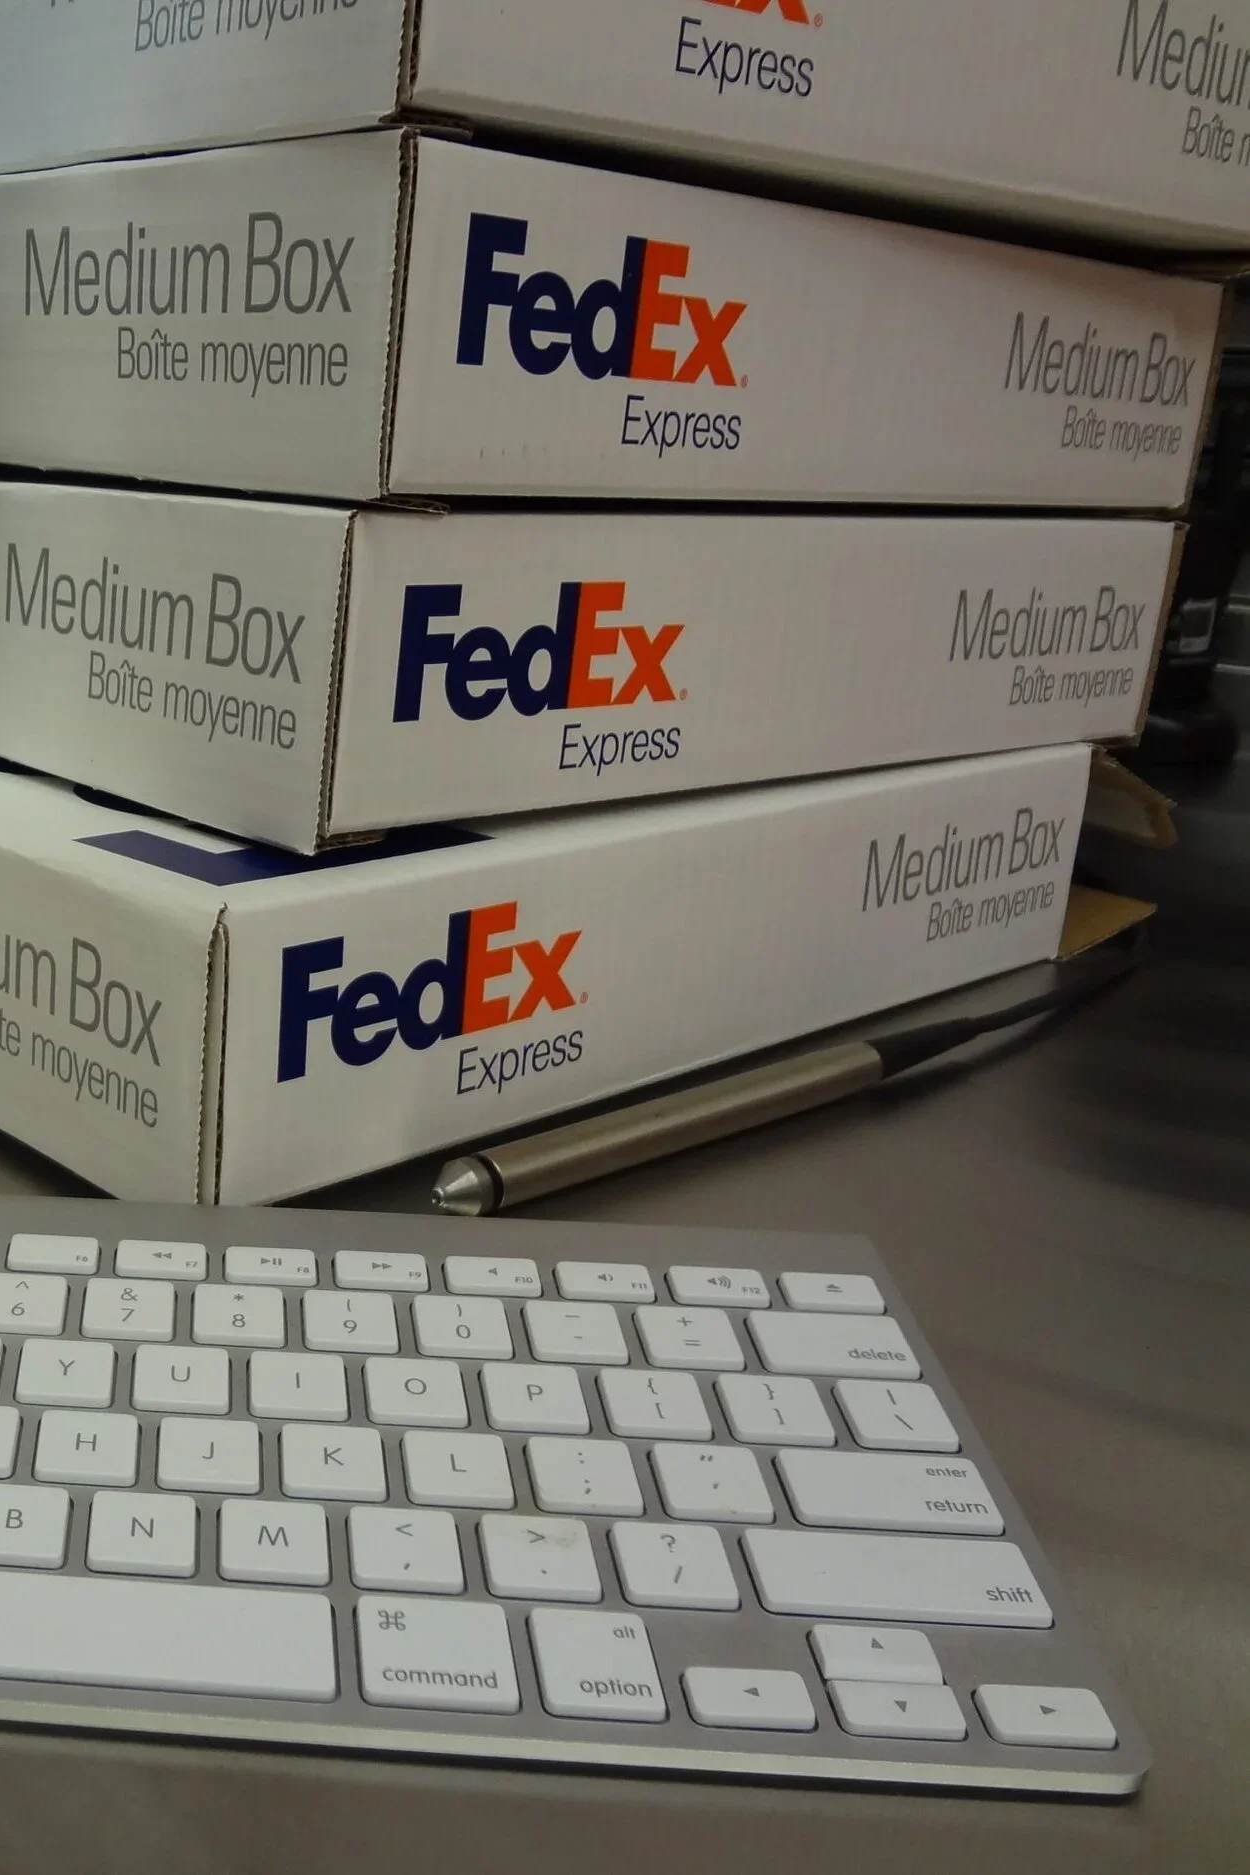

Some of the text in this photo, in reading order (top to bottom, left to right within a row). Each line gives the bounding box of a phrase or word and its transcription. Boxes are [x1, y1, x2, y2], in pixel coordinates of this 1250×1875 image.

[675, 15, 815, 97] Express
[1116, 0, 1250, 110] Mediu
[23, 211, 355, 317] Medium Box
[455, 211, 748, 388] FedEx
[116, 326, 348, 398] Boîte moyenne
[1004, 310, 1196, 407] Medium Box
[621, 394, 742, 460] Express
[1060, 405, 1183, 464] Boîte moyenne
[5, 542, 306, 684] Medium Box
[949, 584, 1147, 662] Medium Box
[392, 580, 686, 724] FedEx
[1008, 664, 1134, 708] Boîte moyenne
[87, 650, 297, 749] Boîte moyenne
[558, 721, 681, 777] Express
[862, 806, 1066, 912] Medium Box
[926, 880, 1055, 942] Boîte moyenne
[69, 937, 163, 1067] Box
[276, 900, 584, 1084] FedEx
[456, 1028, 585, 1097] Express
[31, 1025, 159, 1129] moyenne
[120, 1287, 138, 1302] &
[10, 1302, 26, 1317] 6
[121, 1307, 135, 1323] 7
[231, 1313, 246, 1329] 8
[342, 1319, 358, 1334] 9
[847, 1348, 907, 1362] delete
[58, 1359, 76, 1377] Y
[170, 1365, 191, 1383] U
[404, 1377, 428, 1396] O
[526, 1384, 544, 1402] P
[75, 1432, 98, 1452] H
[201, 1441, 215, 1460] J
[323, 1446, 344, 1466] K
[449, 1453, 467, 1473] L
[925, 1467, 967, 1478] enter
[924, 1499, 989, 1515] return
[5, 1508, 24, 1530] B
[130, 1516, 155, 1539] N
[257, 1525, 289, 1547] M
[985, 1586, 1034, 1603] shift
[612, 1625, 636, 1640] alt
[381, 1668, 499, 1689] command
[579, 1679, 653, 1698] option
